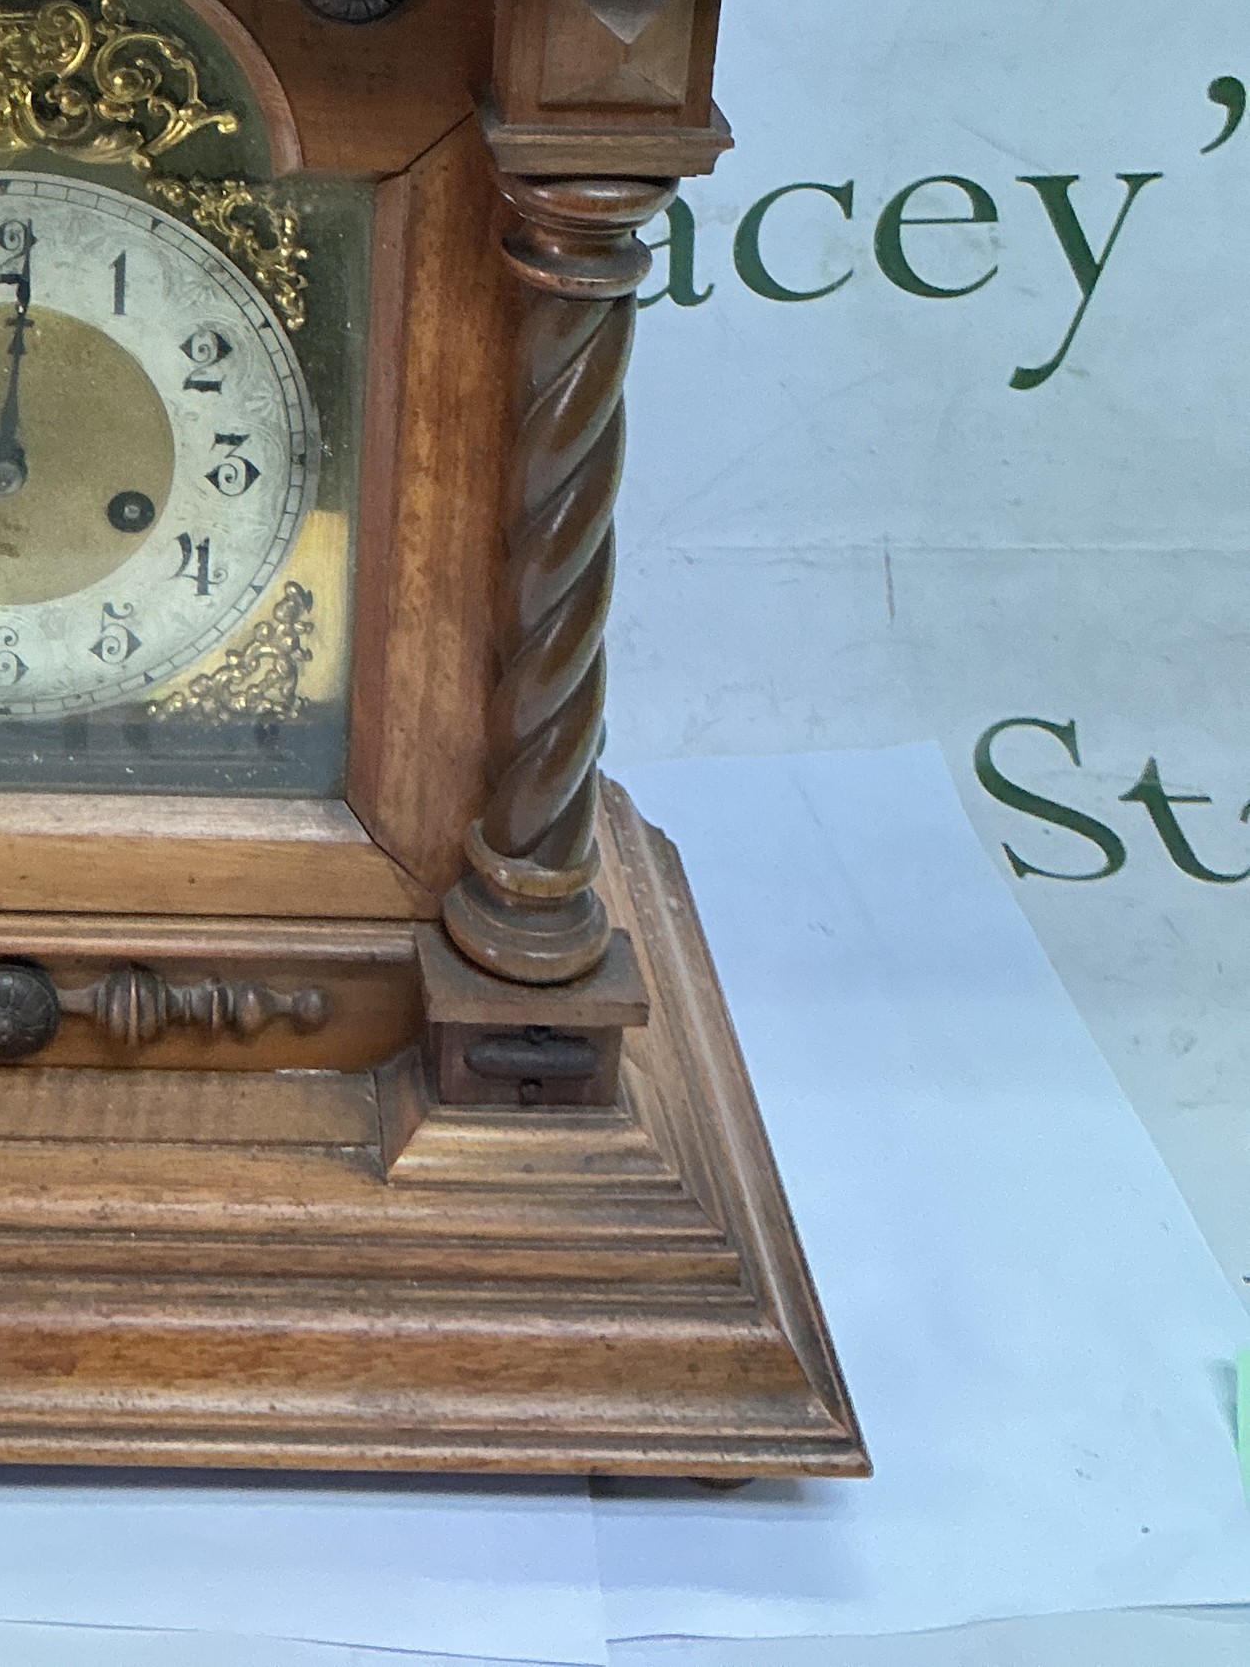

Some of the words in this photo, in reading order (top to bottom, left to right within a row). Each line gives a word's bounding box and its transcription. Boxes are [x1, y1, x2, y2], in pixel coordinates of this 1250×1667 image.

[110, 249, 128, 316] 1
[178, 330, 233, 394] 2
[204, 434, 261, 496] 3
[174, 532, 228, 597] 4
[90, 602, 142, 666] 5
[973, 717, 1250, 884] St
